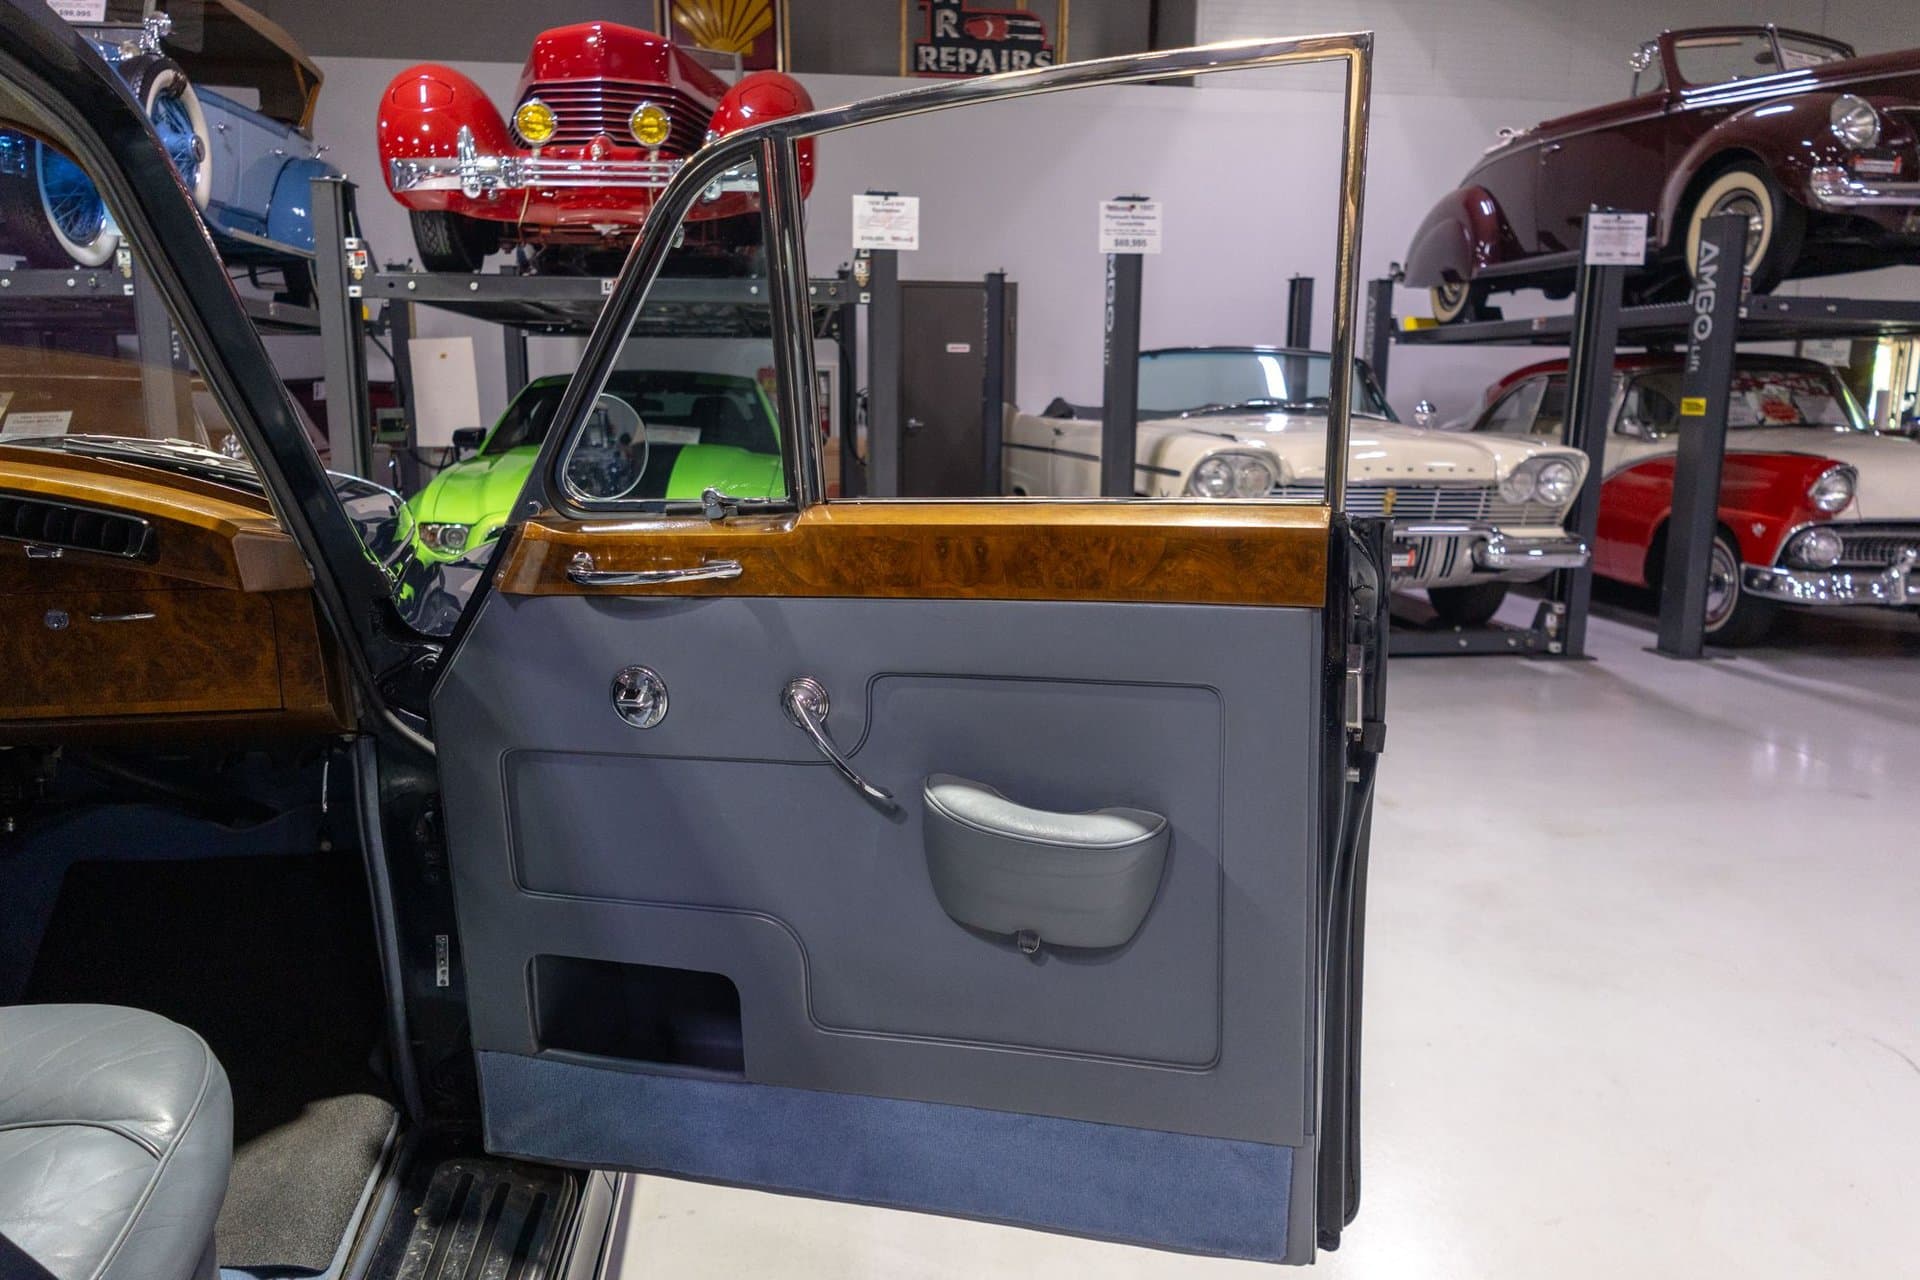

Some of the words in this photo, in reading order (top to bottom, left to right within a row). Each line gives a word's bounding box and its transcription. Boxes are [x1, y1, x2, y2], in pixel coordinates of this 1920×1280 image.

[935, 0, 960, 38] R
[917, 46, 1053, 73] REPAIRS
[1105, 253, 1117, 333] MGO
[1693, 240, 1721, 341] AMGO
